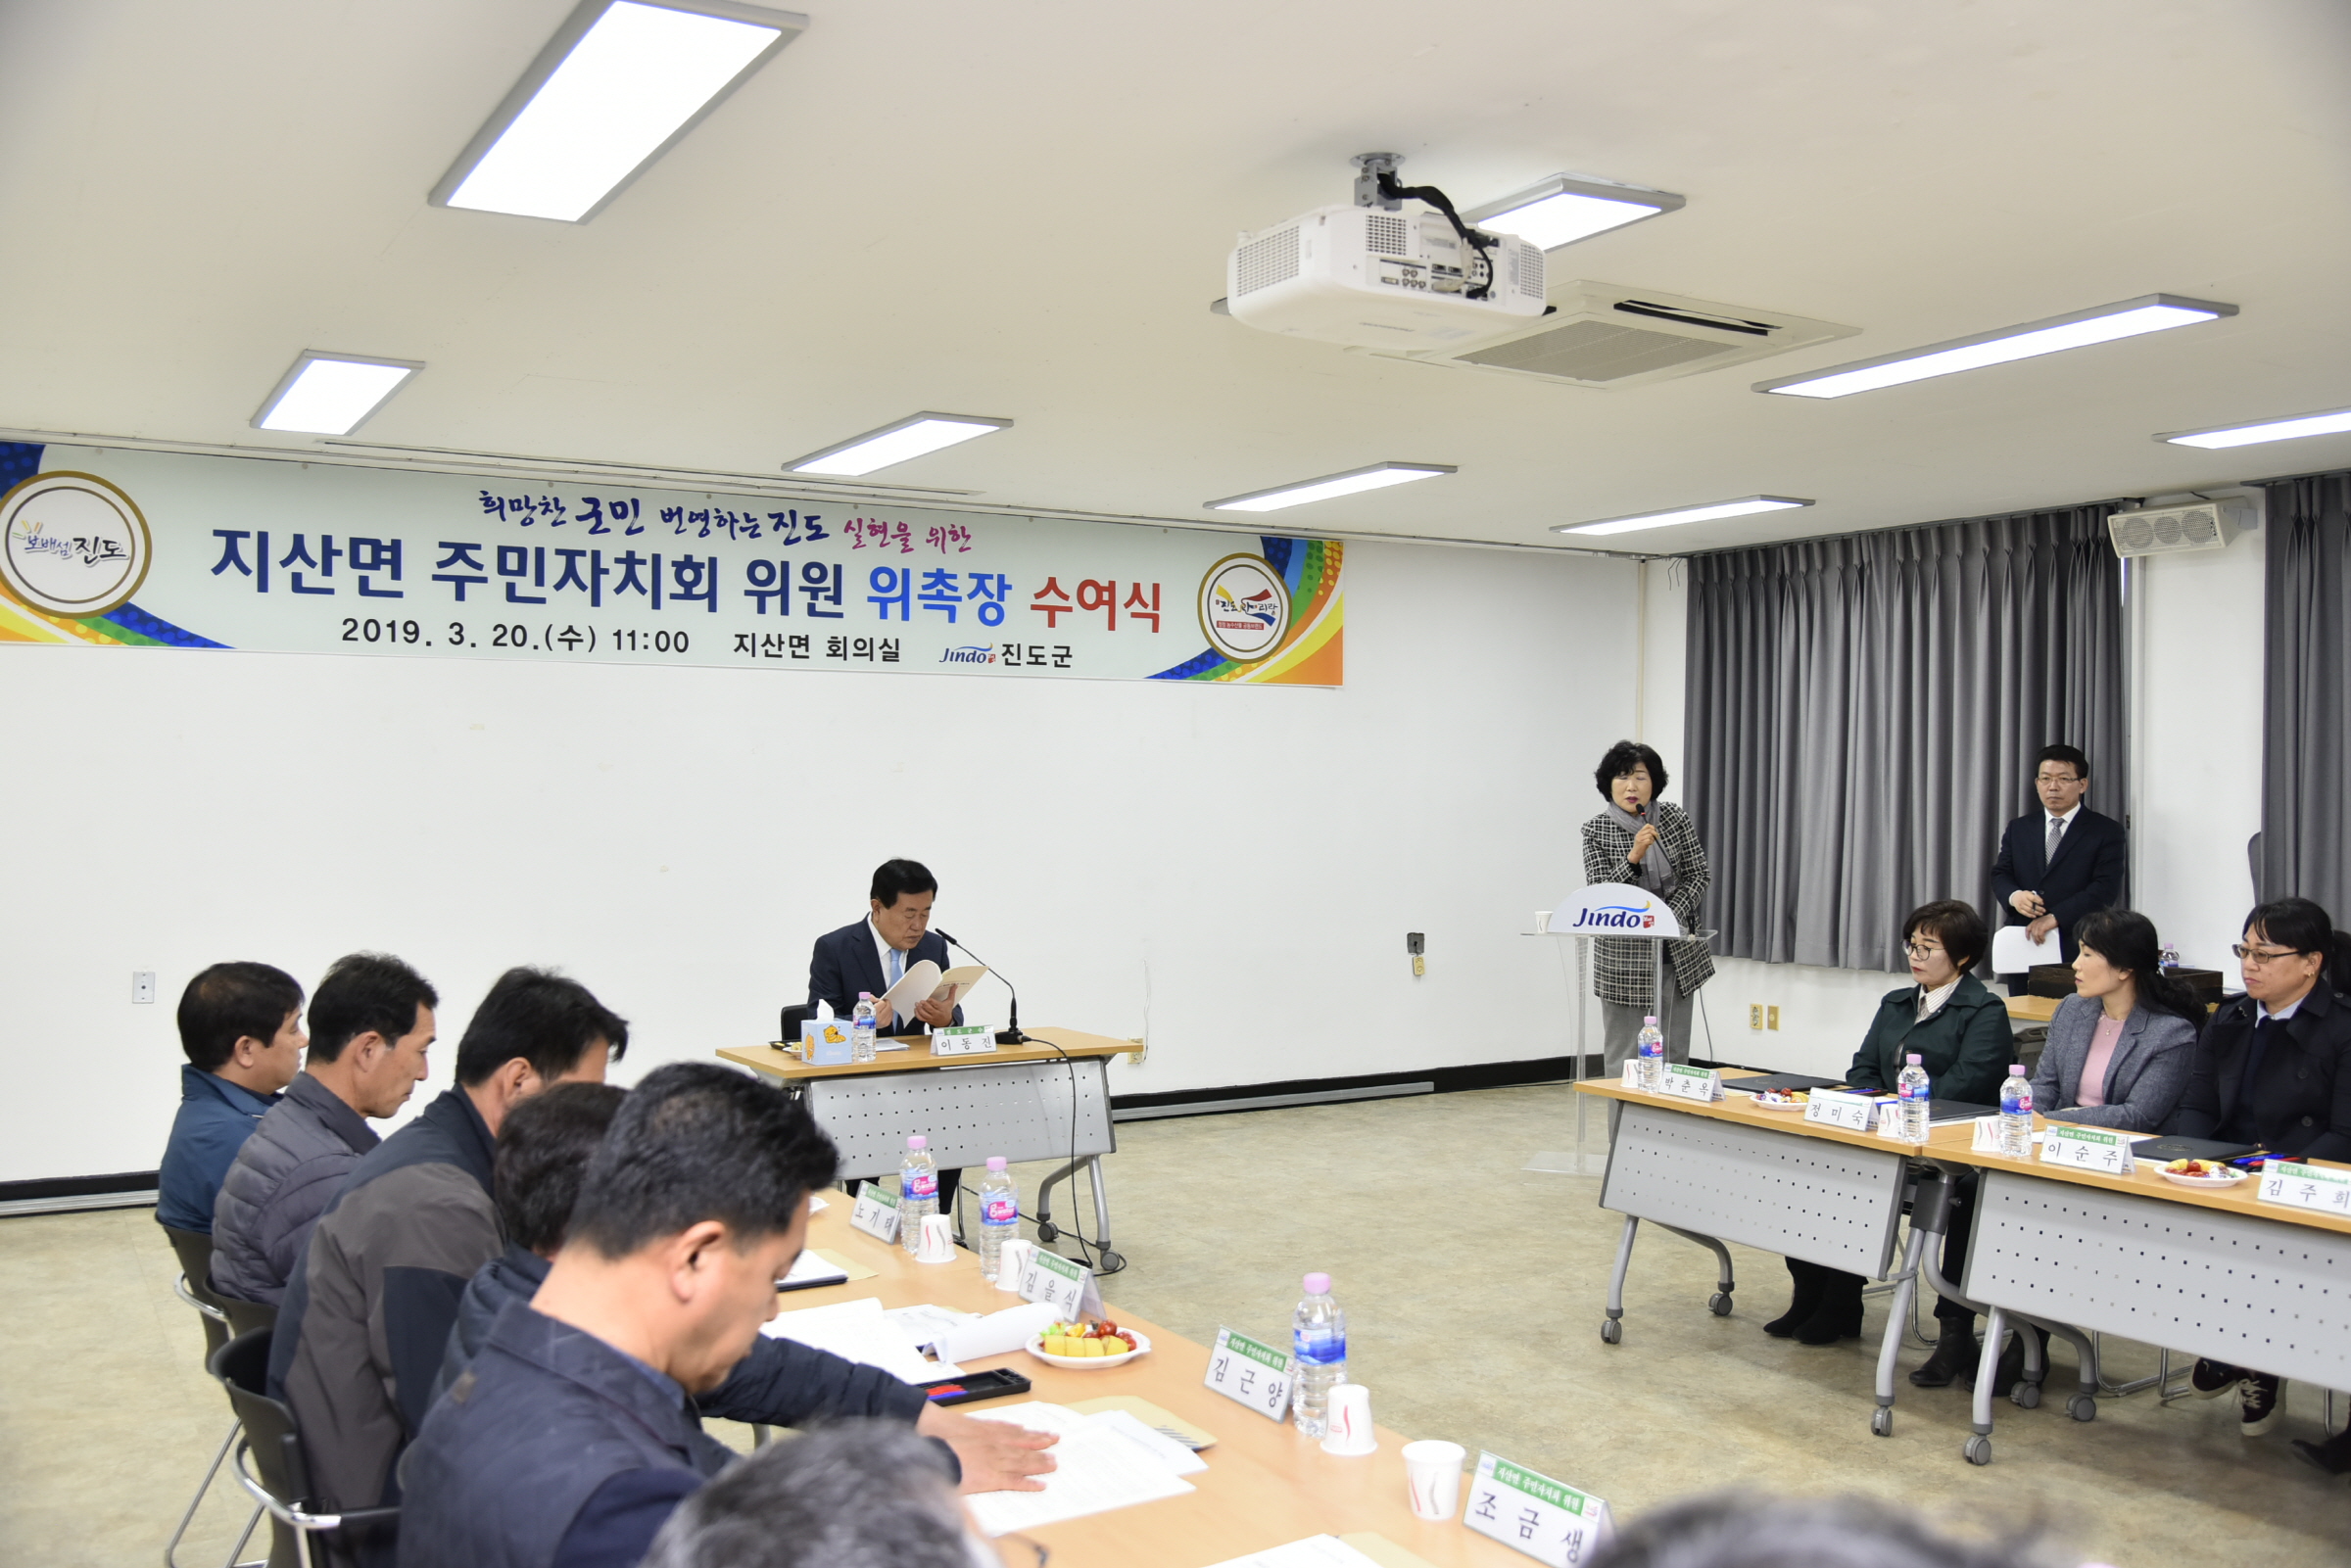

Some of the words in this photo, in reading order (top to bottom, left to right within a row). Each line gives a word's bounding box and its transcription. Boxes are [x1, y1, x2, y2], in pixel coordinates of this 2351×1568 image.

[478, 490, 567, 527] 희망찬
[575, 497, 645, 536] 군민
[659, 505, 762, 541] 번영하는
[767, 509, 830, 546] 진도
[843, 517, 915, 554] 실현을
[926, 523, 972, 554] 위한
[210, 529, 405, 598] 지산면
[431, 541, 718, 613] 주민자치회
[744, 558, 844, 619] 위원
[866, 565, 1013, 627] 위촉장
[1030, 576, 1161, 634] 수여식
[342, 617, 432, 646] 2019.
[448, 622, 477, 648] 3.
[492, 623, 597, 653] 20.(수)
[612, 629, 690, 653] 11:00
[733, 633, 810, 660] 지산면
[826, 636, 900, 663] 회의실
[938, 647, 986, 664] Jindo
[1001, 642, 1073, 669] 진도군
[1572, 907, 1641, 928] Jindo
